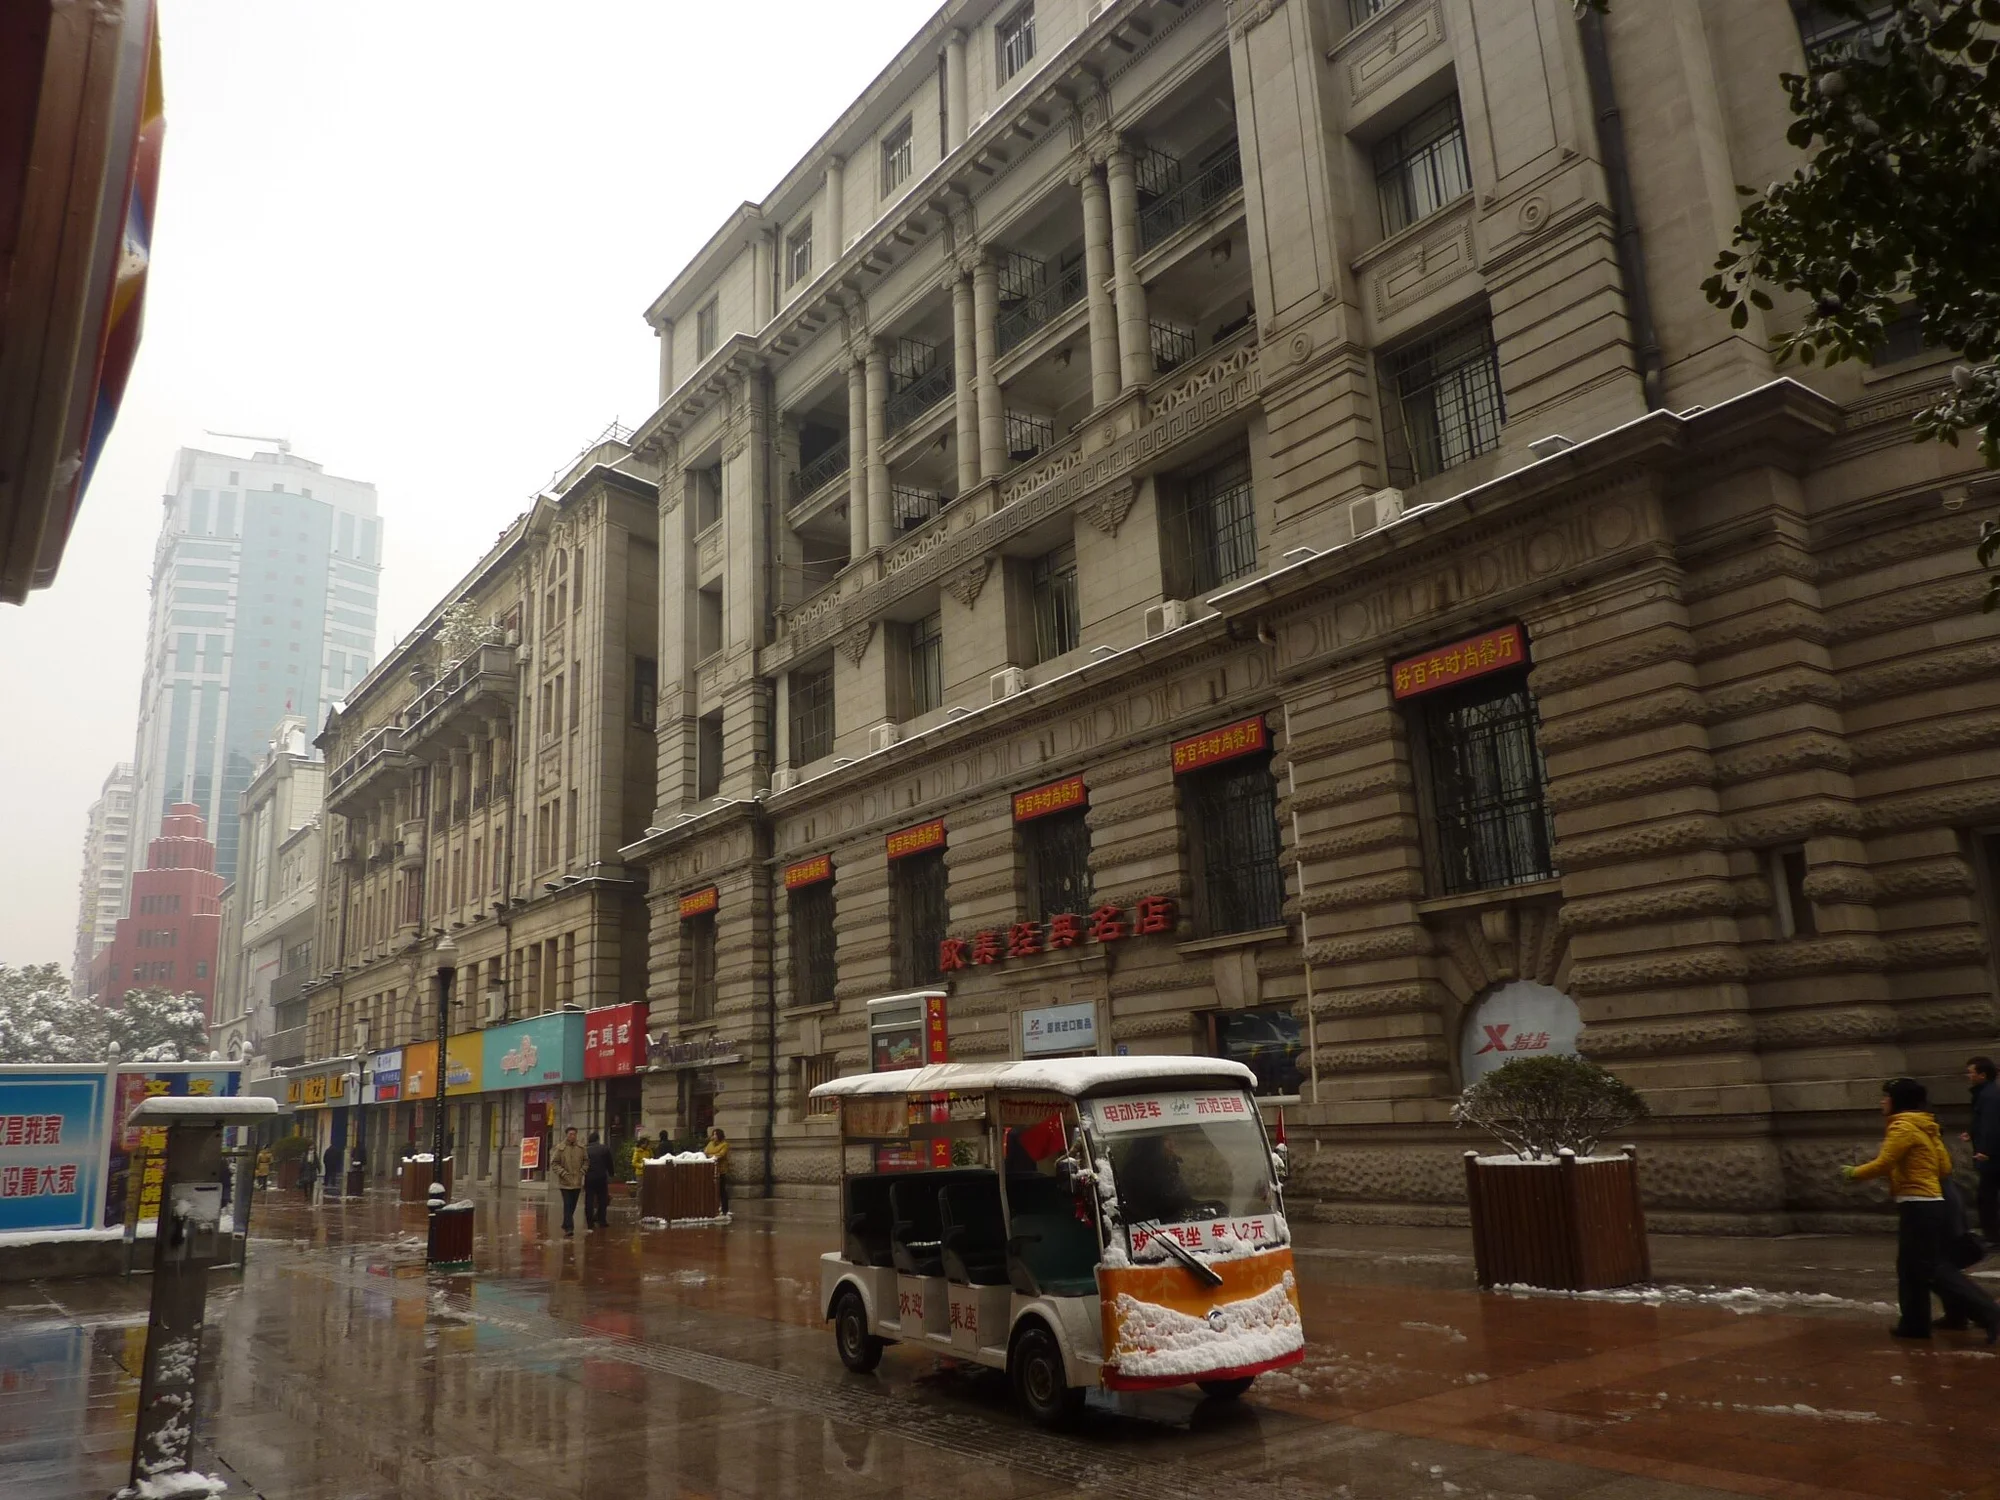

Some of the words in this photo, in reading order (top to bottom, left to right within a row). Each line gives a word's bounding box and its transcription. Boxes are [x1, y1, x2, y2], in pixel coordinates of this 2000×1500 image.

[1395, 633, 1515, 690] 好百年时尚餐厅
[1174, 722, 1258, 767] 好百年时尚餐厅
[1015, 781, 1081, 815] 好百年时尚餐厅
[1511, 1032, 1550, 1050] 特步
[1103, 1101, 1162, 1123] 电动汽车
[1195, 1096, 1245, 1115] 示范运营
[3, 1163, 77, 1197] 设靠大家
[1132, 1225, 1203, 1251] 欢乘坐
[900, 1290, 923, 1318] 欢迎
[950, 1302, 977, 1333] 乘座
